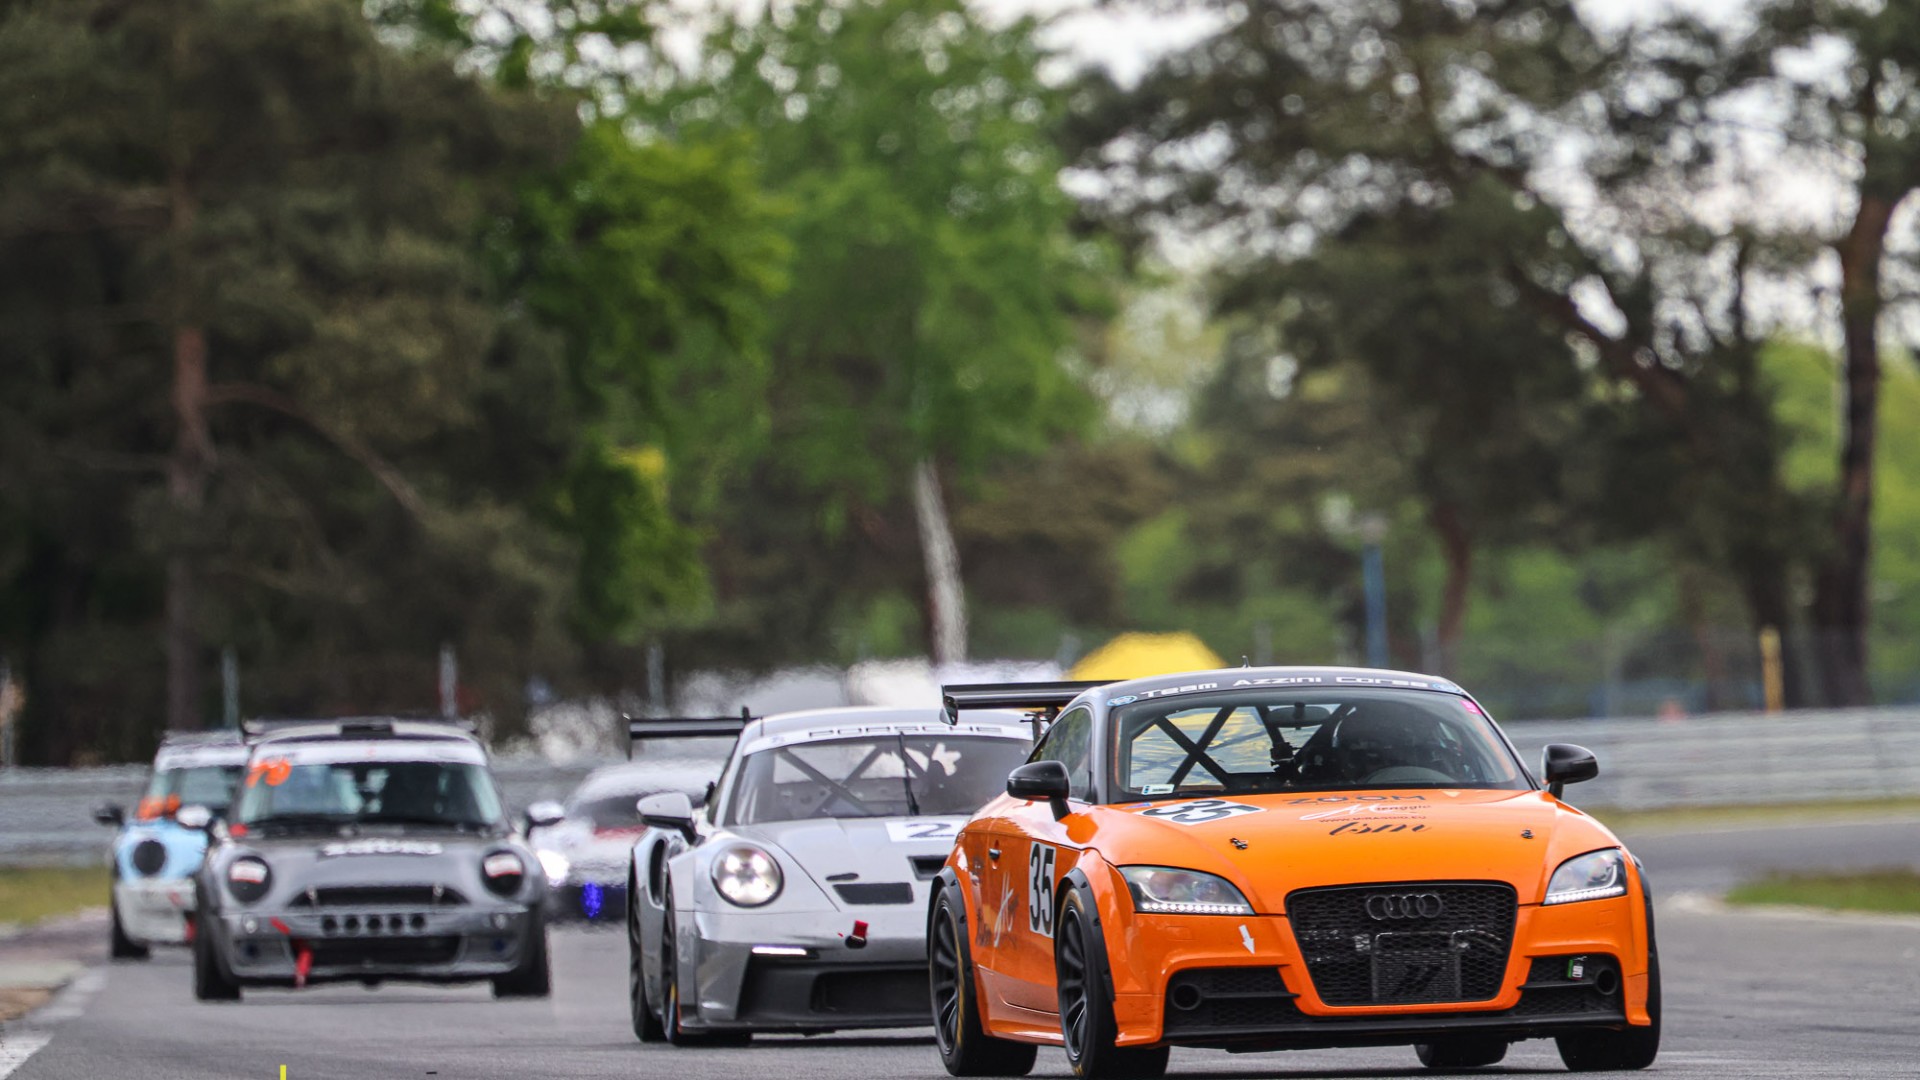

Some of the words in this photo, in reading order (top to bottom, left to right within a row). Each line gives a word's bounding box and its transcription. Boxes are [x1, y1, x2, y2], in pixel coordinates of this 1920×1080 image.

[1140, 682, 1218, 698] Team
[1233, 676, 1322, 687] Azzini
[1336, 676, 1428, 688] Corse
[809, 725, 1002, 738] PORSCHE
[1283, 794, 1426, 806] ZOOM
[1142, 800, 1261, 823] 35
[905, 822, 955, 838] 2
[1030, 843, 1055, 935] 35
